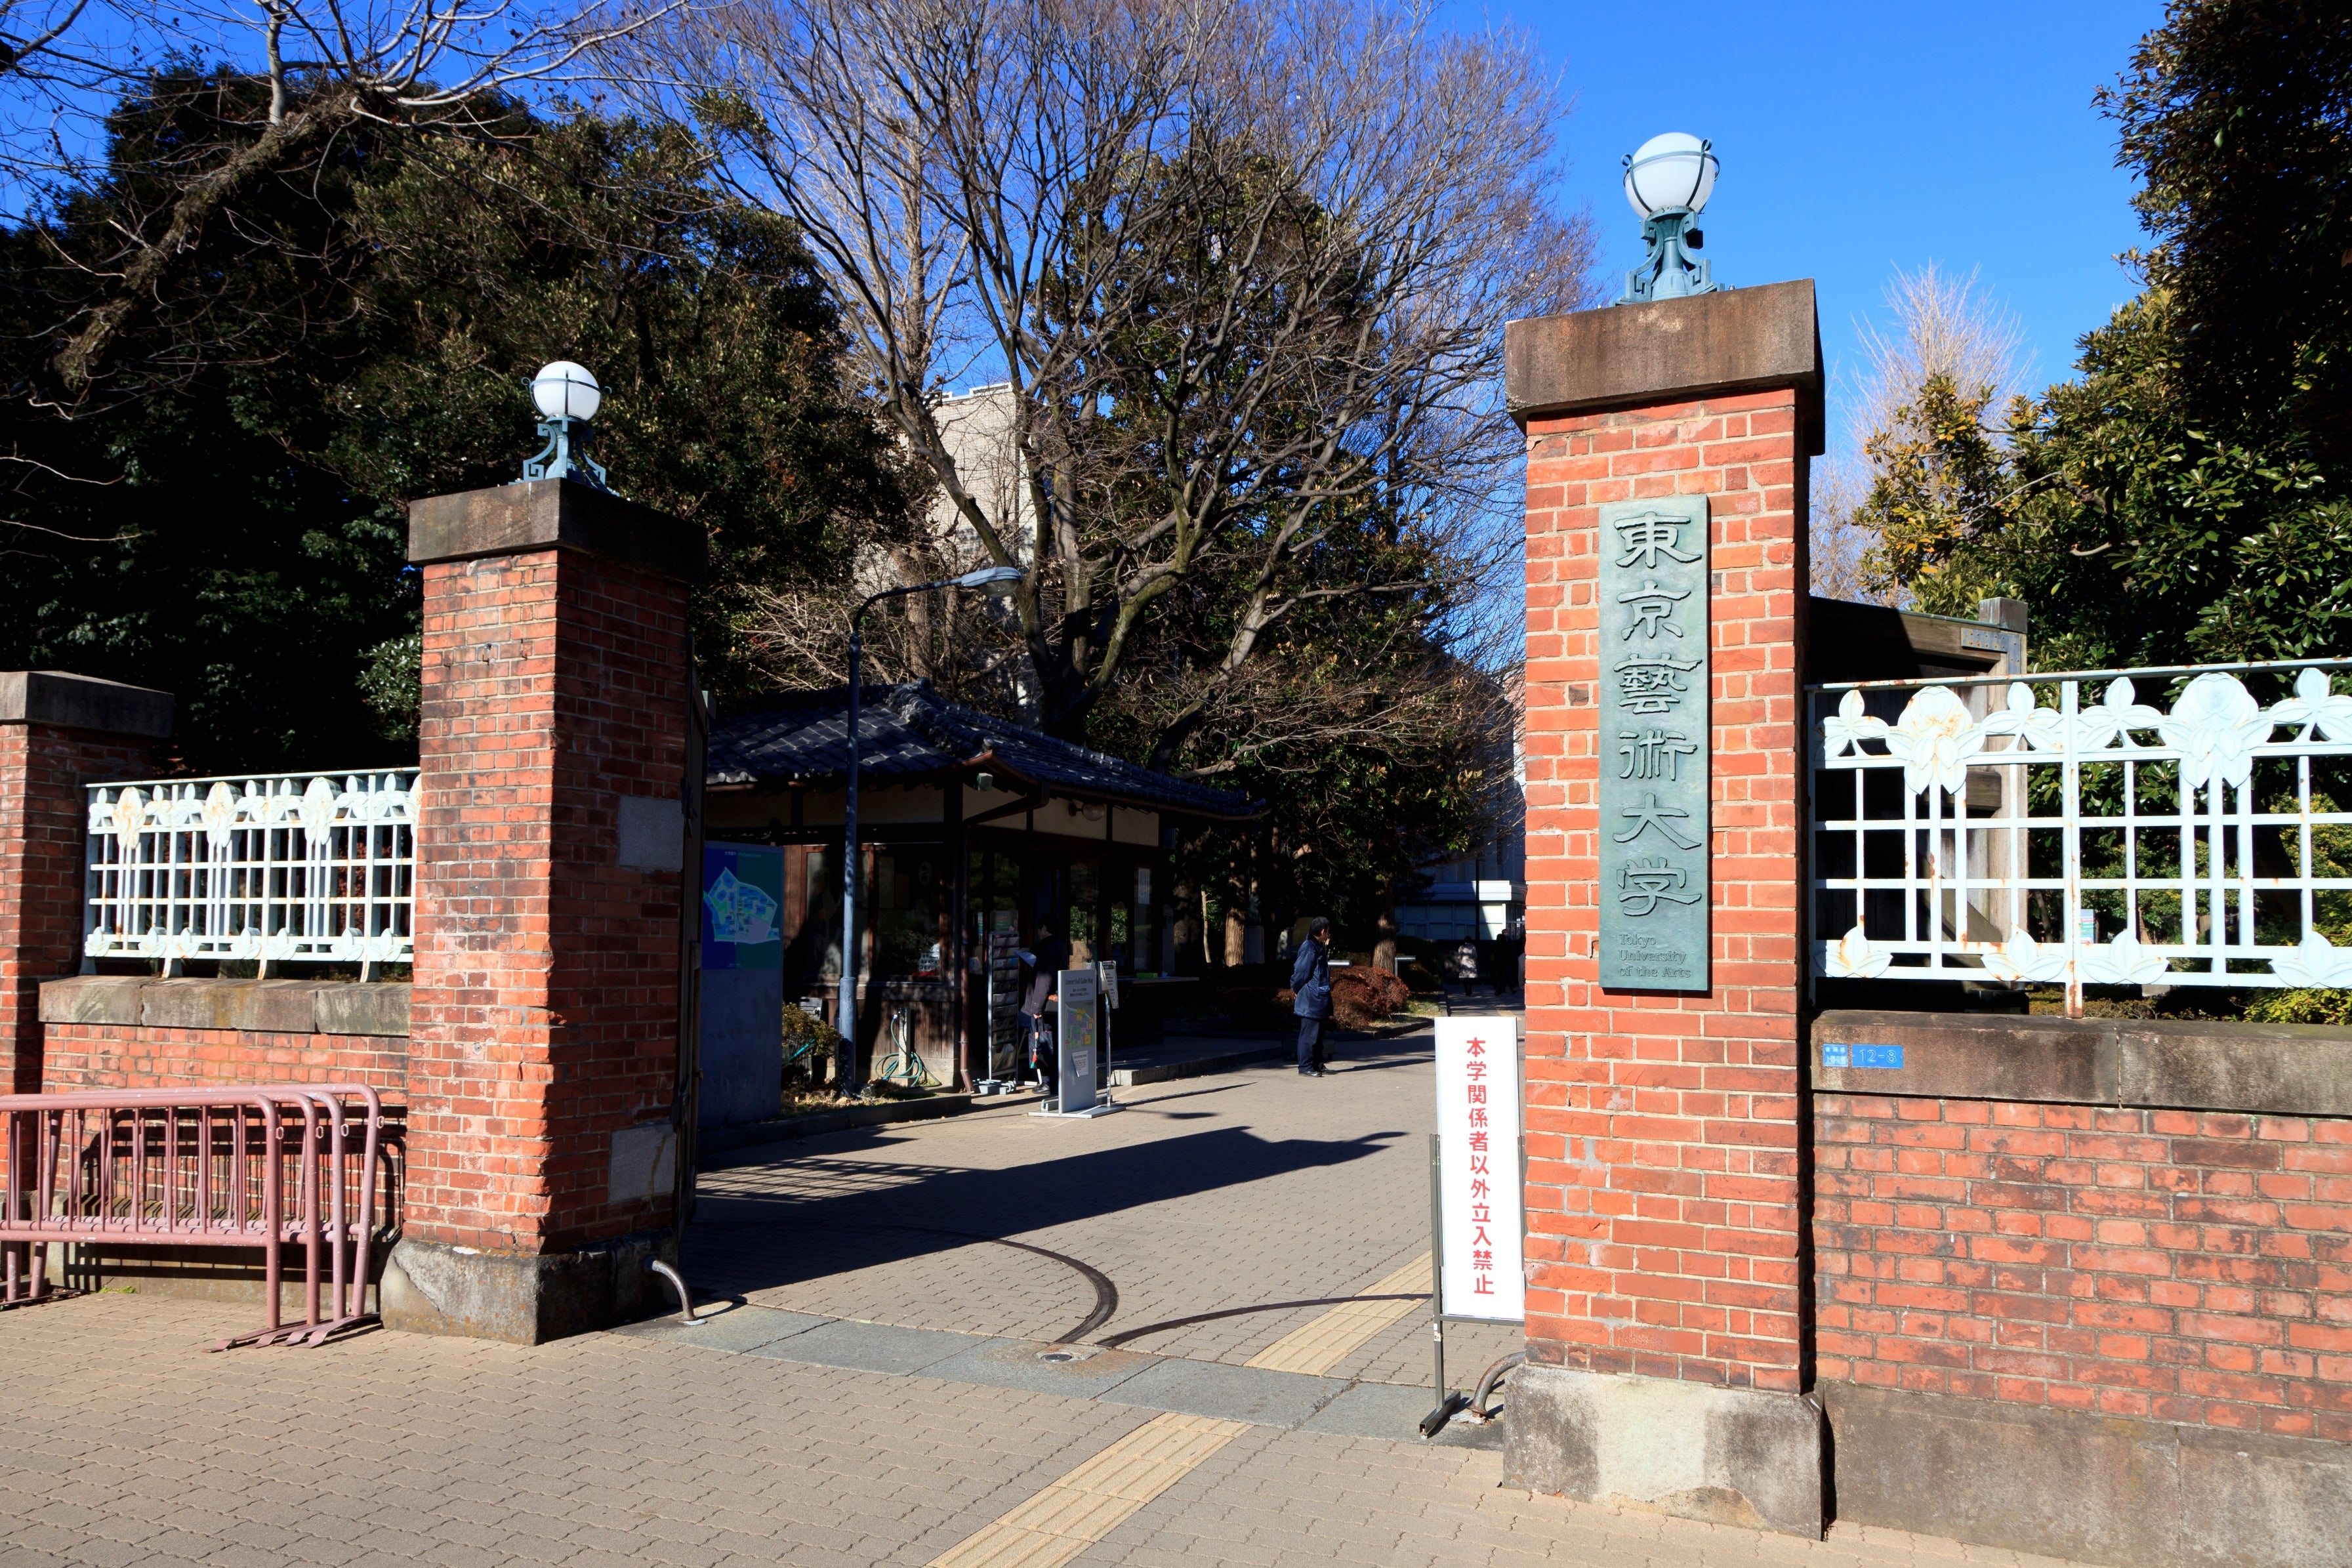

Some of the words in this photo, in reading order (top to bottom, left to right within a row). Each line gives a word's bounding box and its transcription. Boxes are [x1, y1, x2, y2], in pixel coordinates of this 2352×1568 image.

[1613, 511, 1702, 917] 東京藝術大学
[1619, 934, 1657, 948] Tokyo
[1619, 949, 1687, 964] University
[1619, 966, 1634, 977] of
[1637, 966, 1658, 977] the
[1661, 966, 1691, 978] Arts
[1859, 1049, 1897, 1064] 12-8
[1466, 1037, 1495, 1295] 本学関係者以外立入禁止
